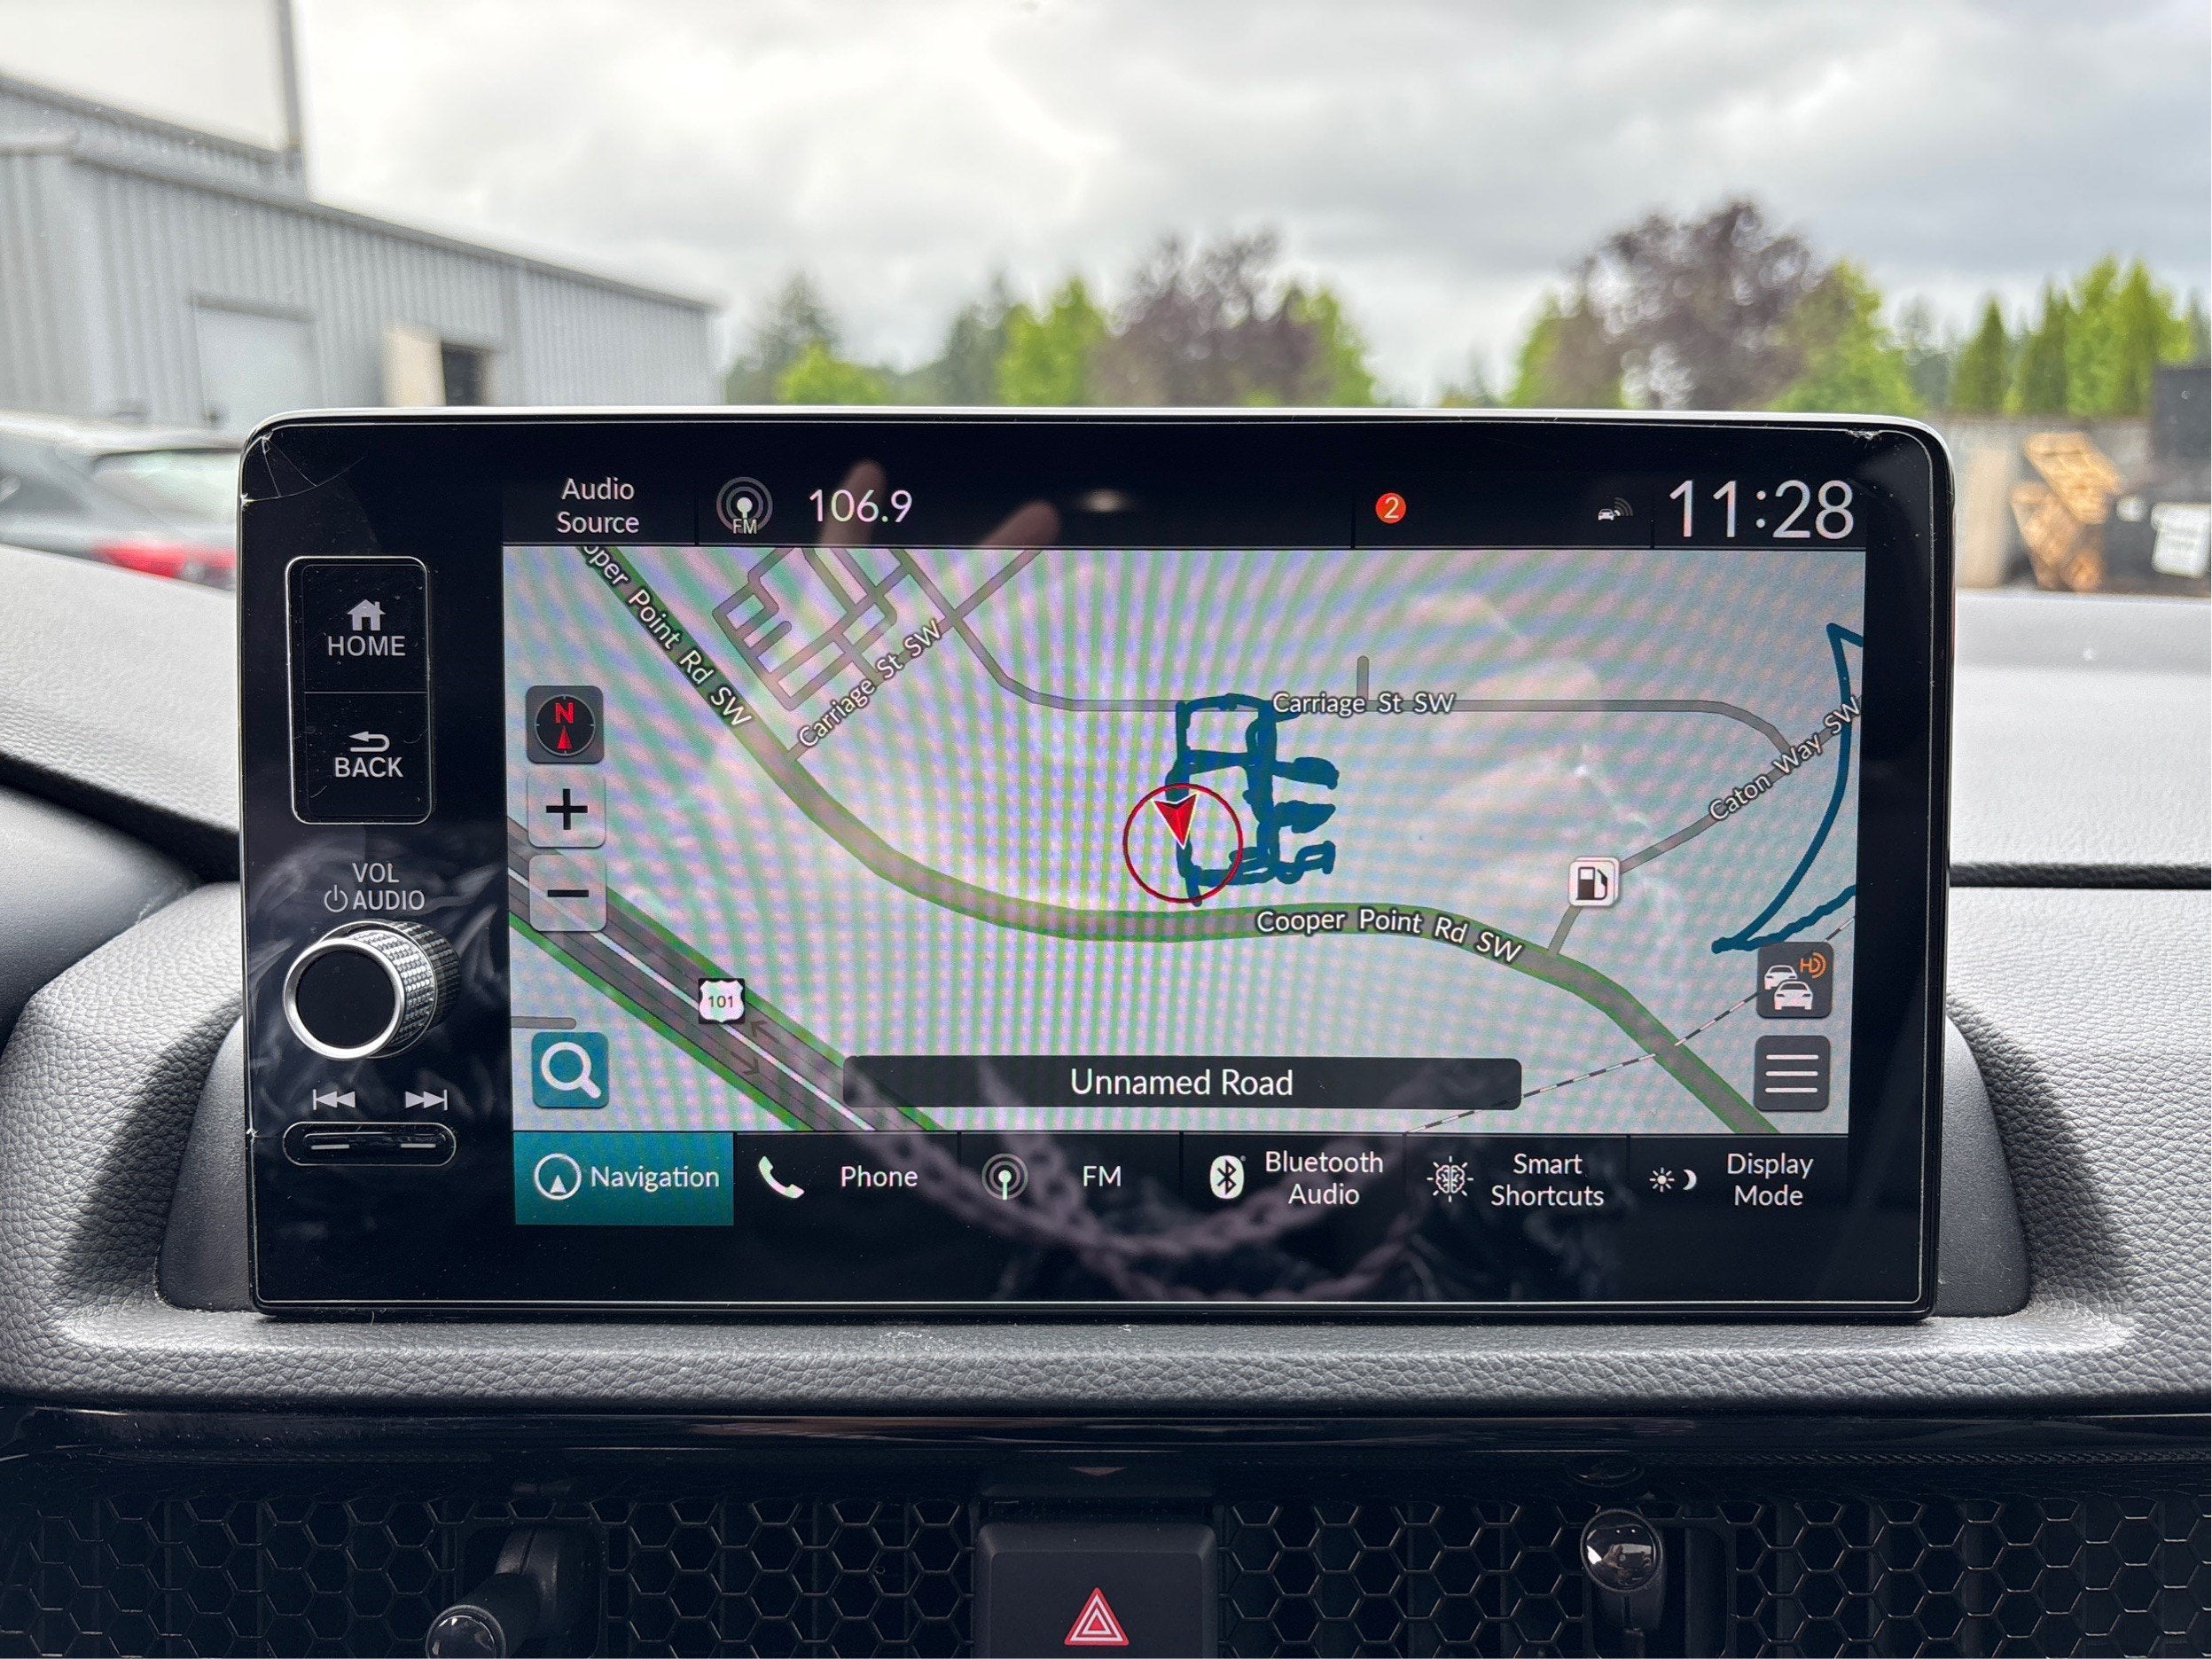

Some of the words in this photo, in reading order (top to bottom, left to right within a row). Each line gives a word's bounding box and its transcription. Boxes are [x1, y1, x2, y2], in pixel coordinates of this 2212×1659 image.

[561, 476, 635, 500] Audio
[809, 489, 912, 523] 106.9
[1384, 497, 1400, 520] 2
[1669, 480, 1854, 540] 11:28
[557, 511, 640, 534] Source
[732, 519, 758, 535] FM
[327, 636, 406, 658] HOME
[629, 589, 681, 650] Point
[679, 650, 714, 685] Rd
[710, 686, 752, 726] SW
[799, 678, 876, 747] Carriage
[876, 654, 904, 680] St
[903, 619, 942, 657] SW
[554, 703, 574, 724] N
[1272, 693, 1365, 715] Carriage
[1378, 693, 1402, 714] St
[1414, 693, 1455, 714] SW
[334, 756, 404, 778] BACK
[1709, 774, 1771, 821] Caton
[1772, 734, 1822, 774] Way
[1824, 696, 1860, 735] SW
[351, 862, 400, 883] VOL
[352, 889, 426, 911] AUDIO
[1256, 911, 1346, 935] Cooper
[1359, 909, 1423, 934] Point
[1434, 917, 1468, 943] Rd
[1476, 931, 1522, 963] SW
[707, 994, 735, 1009] 101
[1071, 1068, 1210, 1095] Unnamed
[1222, 1068, 1293, 1096] Road
[1265, 1149, 1384, 1173] Bluetooth
[1512, 1153, 1583, 1175] Smart
[1727, 1153, 1814, 1181] Display
[590, 1165, 720, 1193] Navigation
[841, 1164, 918, 1187] Phone
[1083, 1165, 1122, 1187] FM
[1287, 1182, 1360, 1205] Audio
[1490, 1184, 1605, 1207] Shortcuts
[1734, 1184, 1803, 1206] Mode
